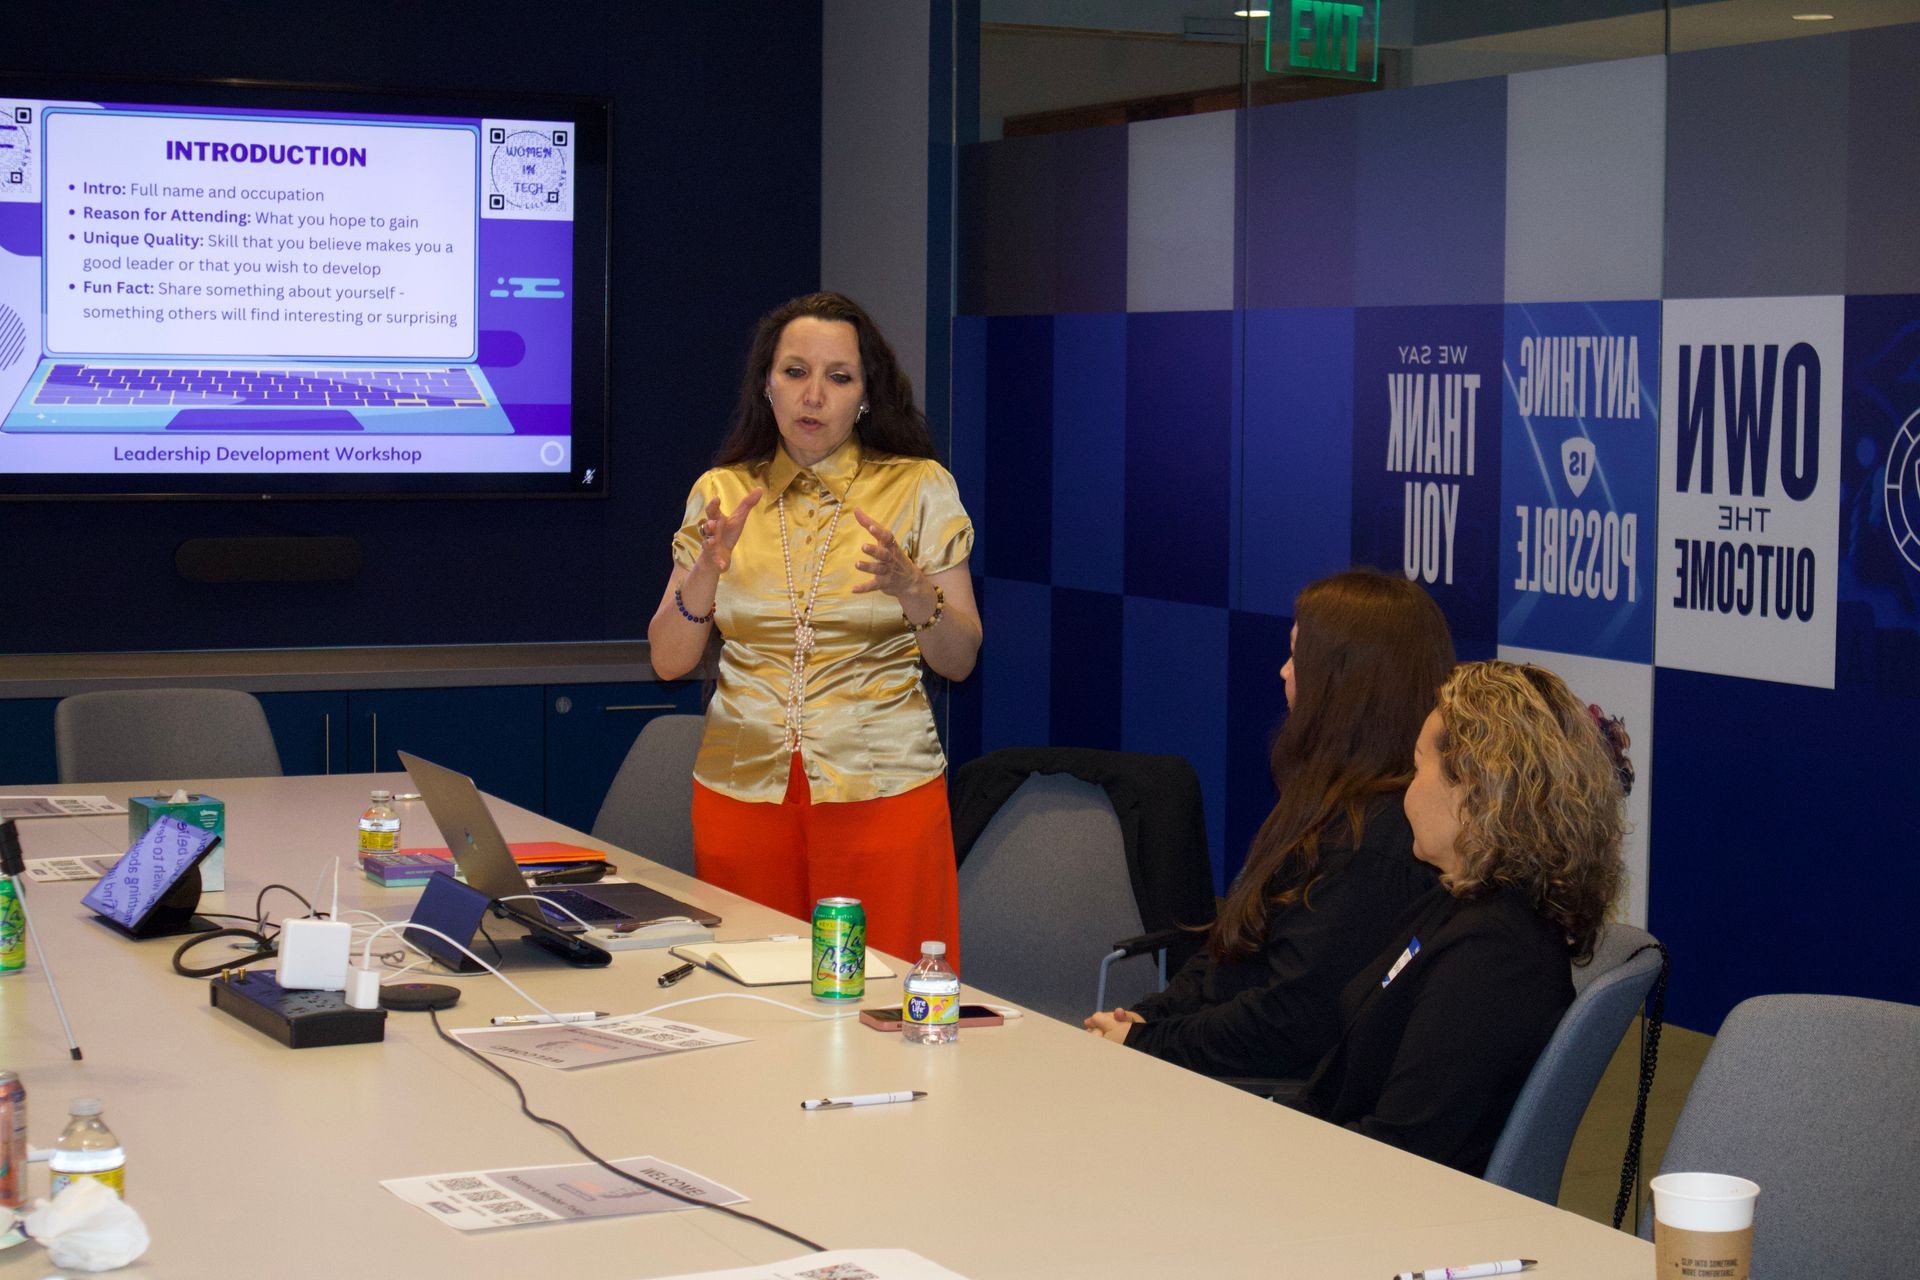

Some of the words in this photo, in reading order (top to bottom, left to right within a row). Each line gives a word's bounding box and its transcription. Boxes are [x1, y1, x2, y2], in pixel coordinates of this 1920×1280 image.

[1290, 0, 1363, 72] EXIT
[166, 140, 367, 167] INTRODUCTION
[506, 146, 552, 158] WOMEN
[83, 182, 126, 196] Intro:
[131, 183, 158, 197] Full
[162, 186, 204, 199] name
[208, 186, 236, 199] and
[240, 188, 324, 203] occupation
[513, 182, 543, 195] TECH
[83, 206, 140, 221] Reason
[144, 207, 167, 221] for
[171, 209, 251, 227] Attending:
[255, 211, 294, 225] What
[298, 214, 324, 229] you
[329, 213, 366, 229] hope
[370, 216, 385, 228] to
[389, 215, 419, 231] gain
[83, 231, 139, 248] Unique
[144, 233, 204, 250] Quality:
[208, 234, 238, 248] Skill
[243, 235, 273, 249] that
[277, 239, 304, 252] you
[309, 237, 362, 251] believe
[366, 239, 411, 252] makes
[415, 242, 441, 256] you
[445, 243, 453, 253] a
[83, 257, 121, 272] good
[126, 257, 174, 270] leader
[178, 260, 195, 271] or
[199, 259, 230, 272] that
[234, 262, 261, 275] you
[266, 260, 298, 273] wish
[303, 262, 318, 274] to
[323, 262, 381, 278] develop
[83, 281, 112, 294] Fun
[117, 282, 154, 295] Fact:
[158, 282, 201, 296] Share
[206, 283, 284, 301] something
[288, 285, 331, 298] about
[336, 286, 395, 302] yourself
[83, 306, 164, 323] something
[168, 307, 217, 320] others
[221, 308, 246, 321] will
[251, 308, 279, 321] find
[284, 309, 363, 326] interesting
[367, 312, 382, 323] or
[386, 312, 457, 328] surprising
[114, 446, 211, 464] Leadership
[216, 446, 330, 465] Development
[335, 446, 422, 464] Workshop
[911, 998, 926, 1007] Pure
